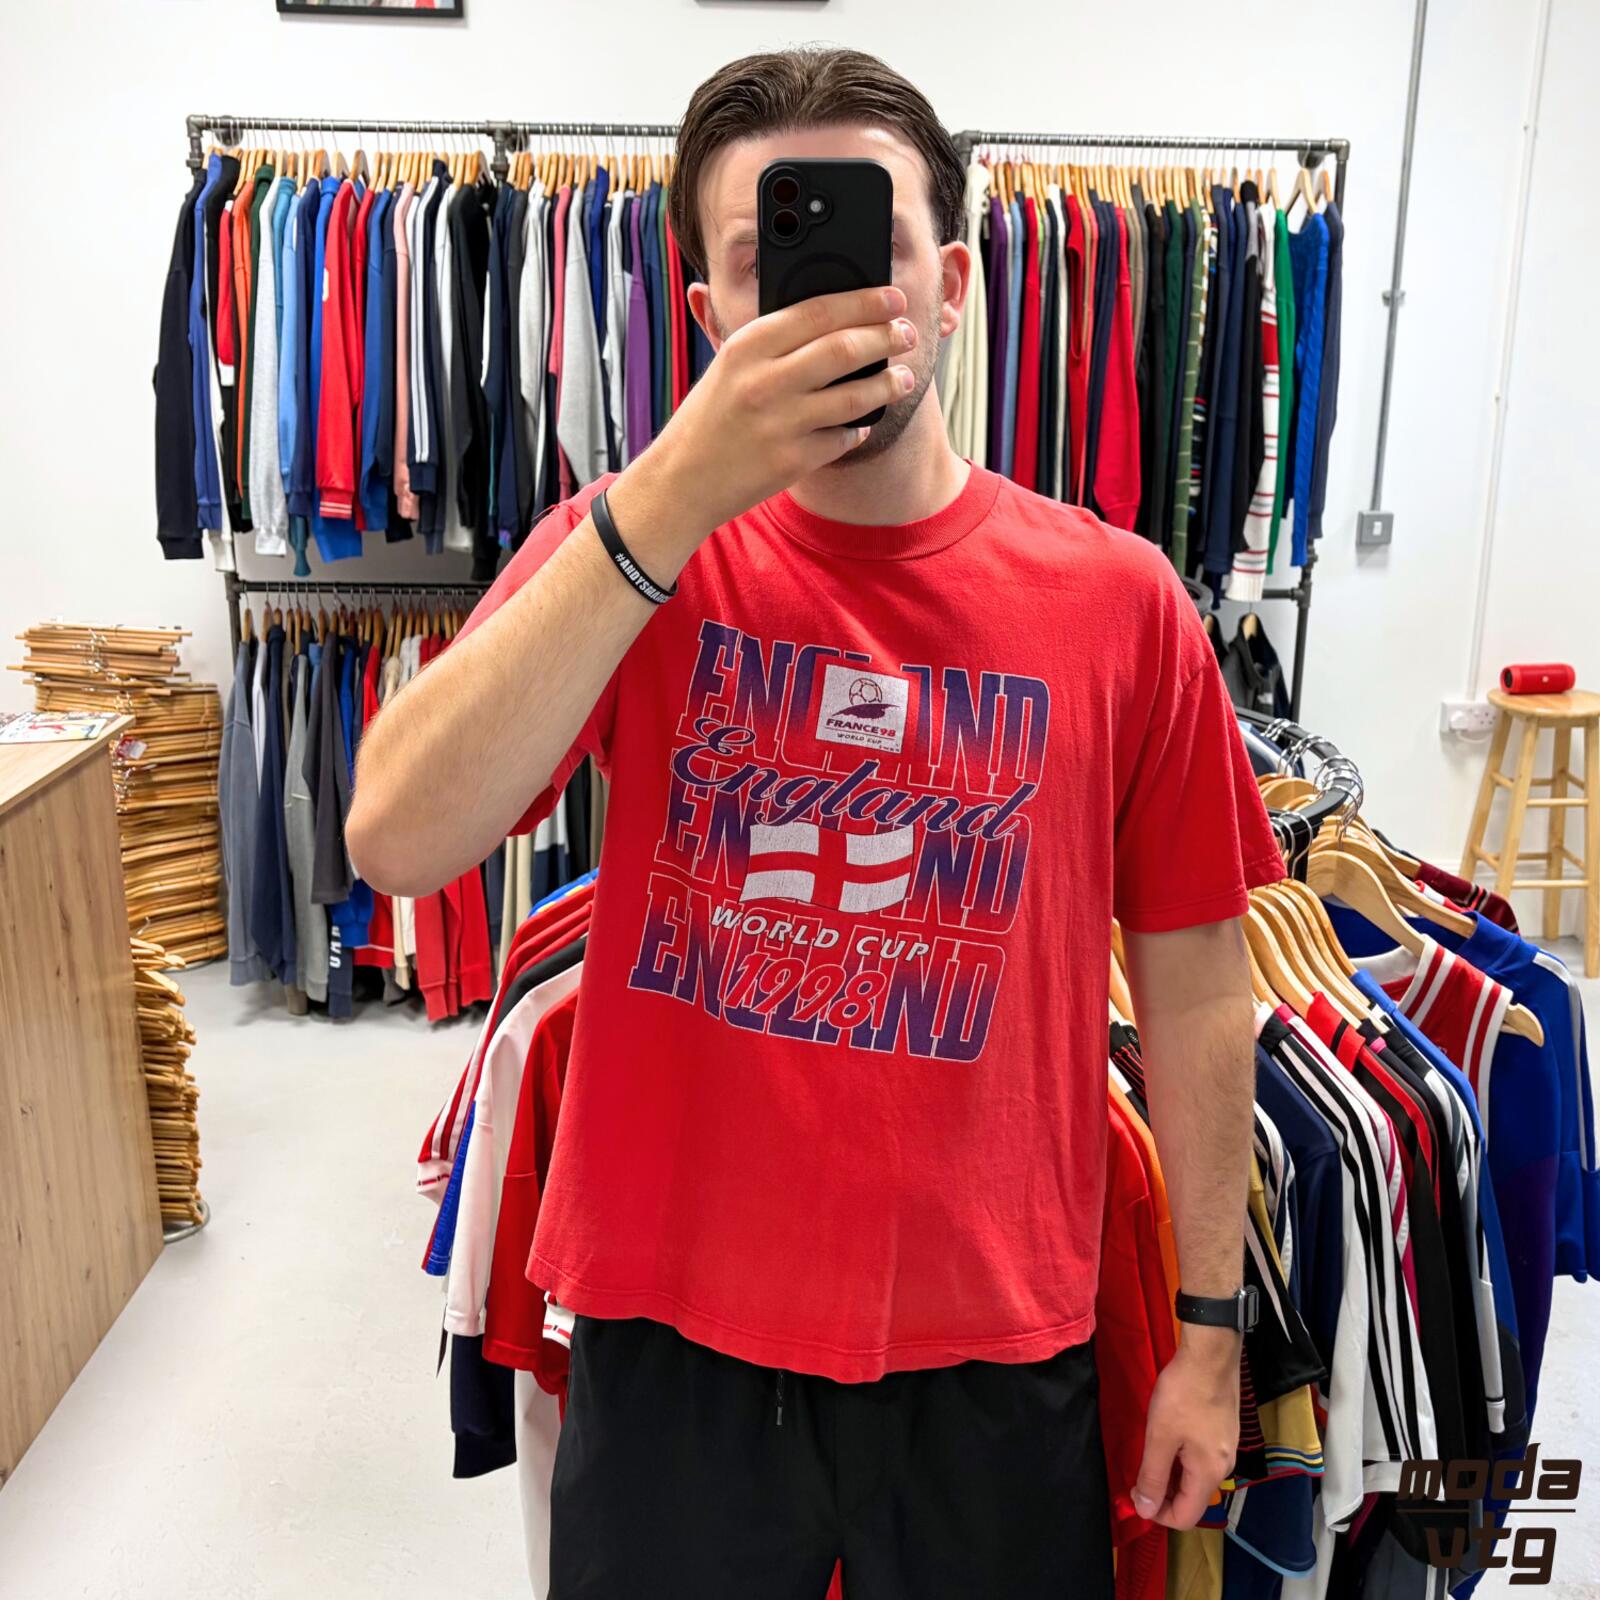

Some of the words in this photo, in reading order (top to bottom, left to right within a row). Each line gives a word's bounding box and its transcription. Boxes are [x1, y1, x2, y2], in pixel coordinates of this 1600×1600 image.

[672, 717, 1037, 841] England
[711, 904, 840, 949] WORLD
[856, 935, 930, 962] CUP
[724, 950, 887, 1029] 1998
